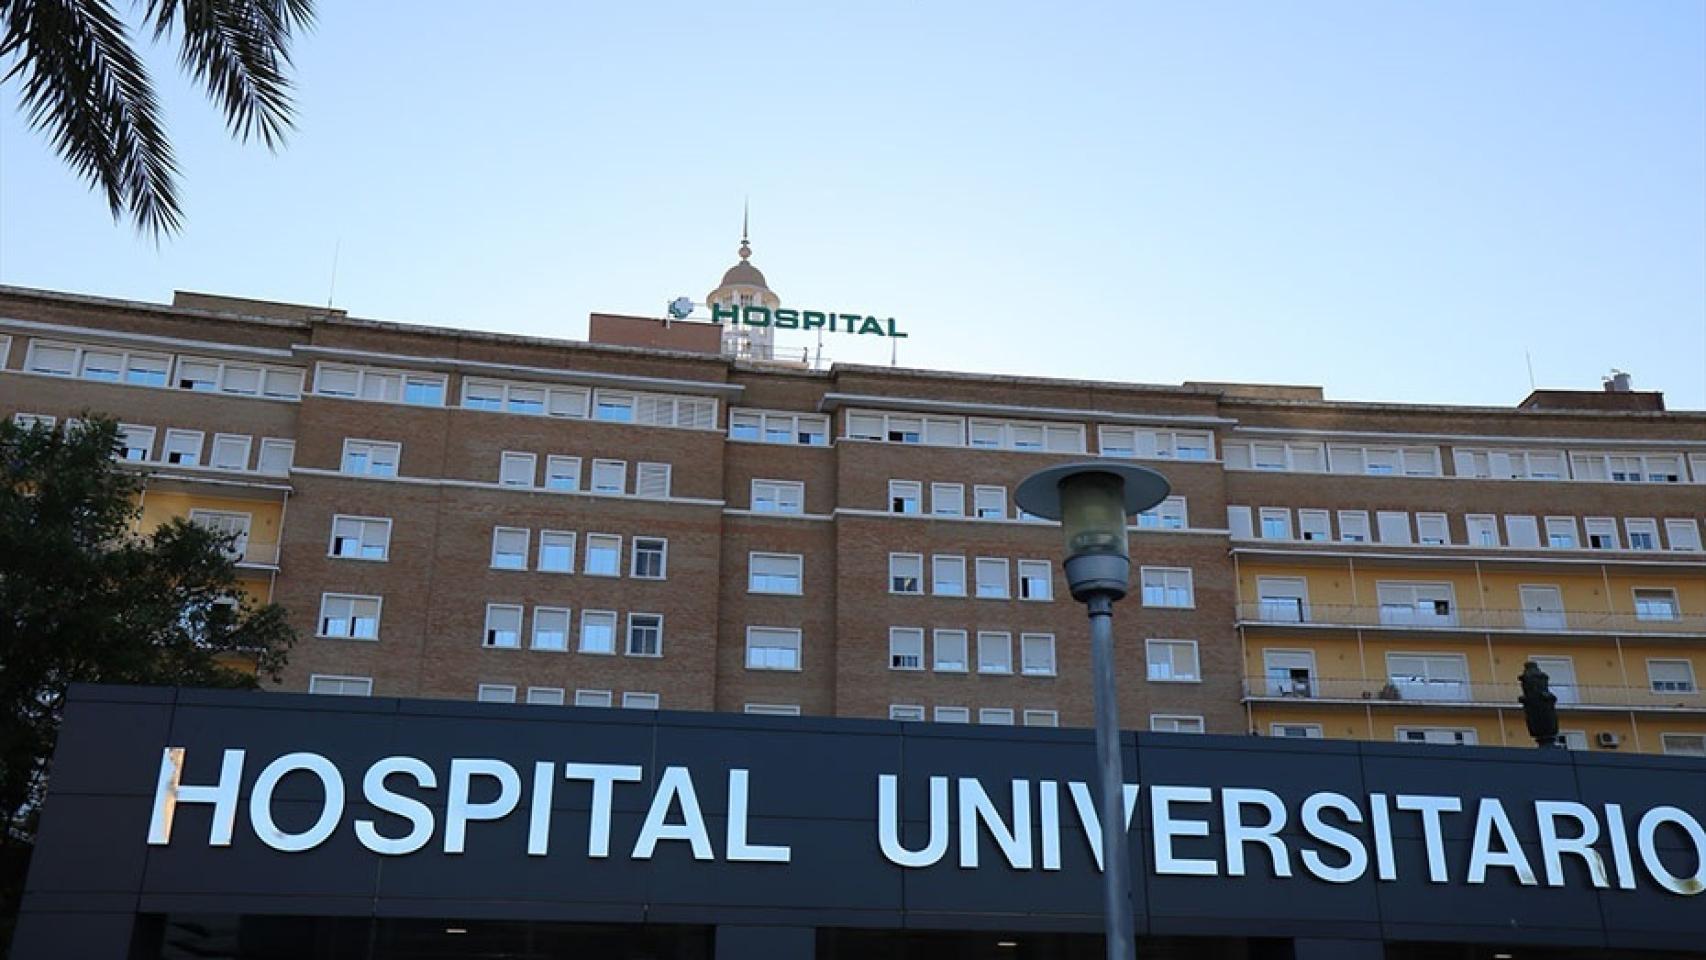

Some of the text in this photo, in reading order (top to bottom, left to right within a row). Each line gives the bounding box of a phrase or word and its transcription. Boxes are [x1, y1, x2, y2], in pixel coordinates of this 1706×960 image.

[712, 302, 908, 338] HOSPITAL
[147, 746, 1706, 895] HOSPITAL UNIVERSITARIO
